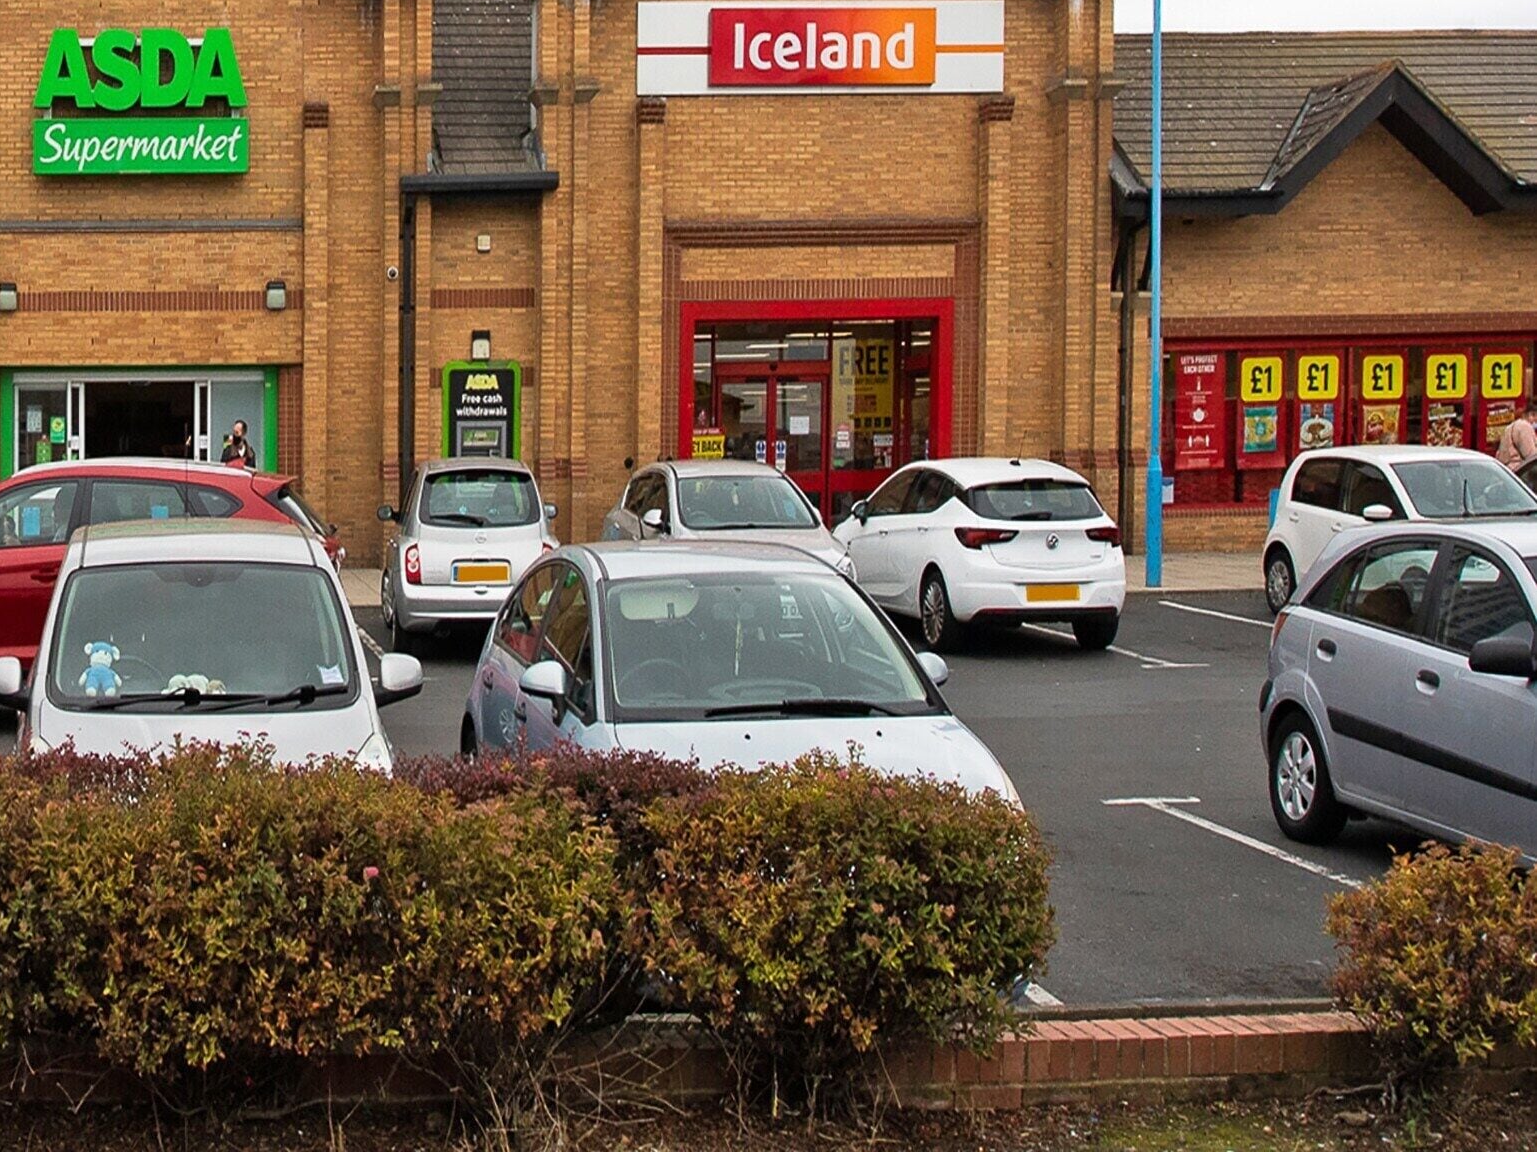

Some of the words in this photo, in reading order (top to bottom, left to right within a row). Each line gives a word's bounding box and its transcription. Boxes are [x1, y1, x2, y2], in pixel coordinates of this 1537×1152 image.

[733, 22, 915, 70] Iceland
[33, 26, 248, 111] ASDA
[39, 123, 243, 173] Supermarket
[839, 345, 889, 376] FREE
[1183, 365, 1197, 374] EACH
[1197, 364, 1215, 374] OTHER
[1195, 354, 1218, 364] PROTECT
[1250, 365, 1272, 393] £1
[1307, 363, 1329, 391] £1
[1371, 363, 1393, 391] £1
[1435, 362, 1457, 390] £1
[1490, 362, 1512, 390] £1
[455, 406, 508, 416] withdrawals
[461, 394, 481, 404] Free
[482, 394, 503, 404] cash
[702, 440, 722, 452] BACK
